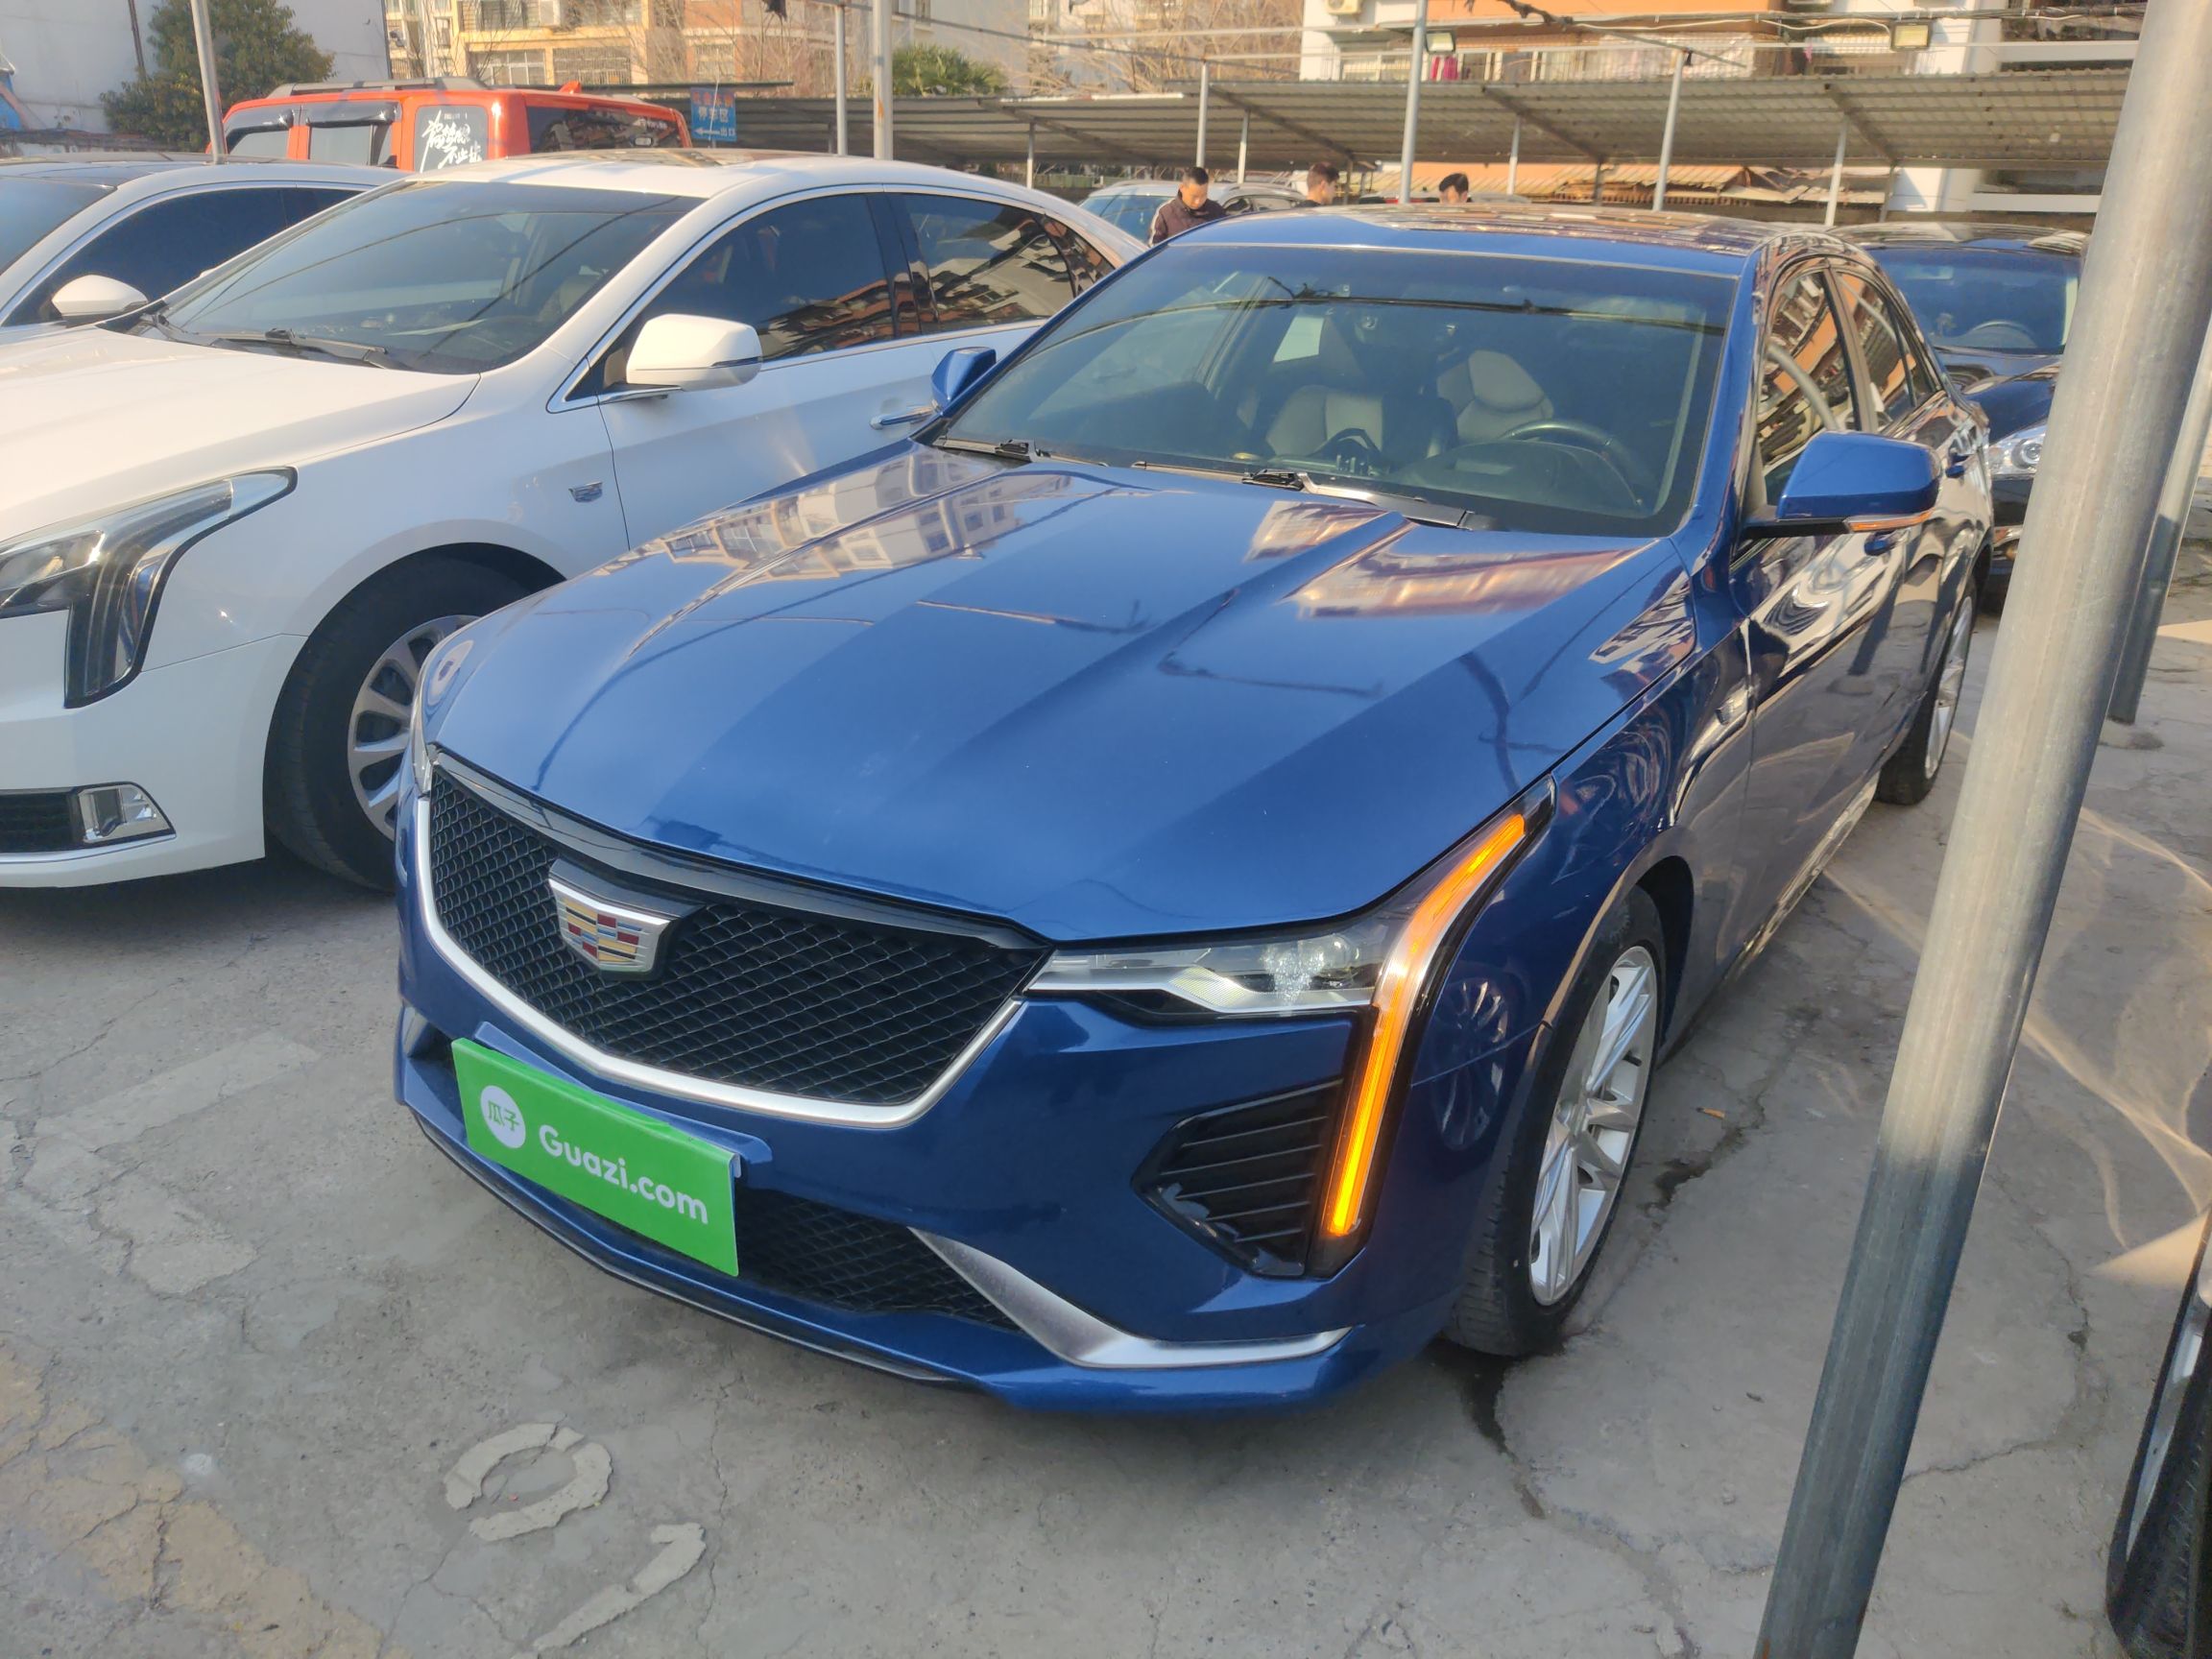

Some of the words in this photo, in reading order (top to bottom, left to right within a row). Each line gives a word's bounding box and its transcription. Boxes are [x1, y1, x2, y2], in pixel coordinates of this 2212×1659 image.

[698, 106, 729, 123] 停车区
[720, 127, 735, 136] 出口
[488, 1100, 519, 1131] 瓜子
[539, 1124, 709, 1224] Guazi.com
